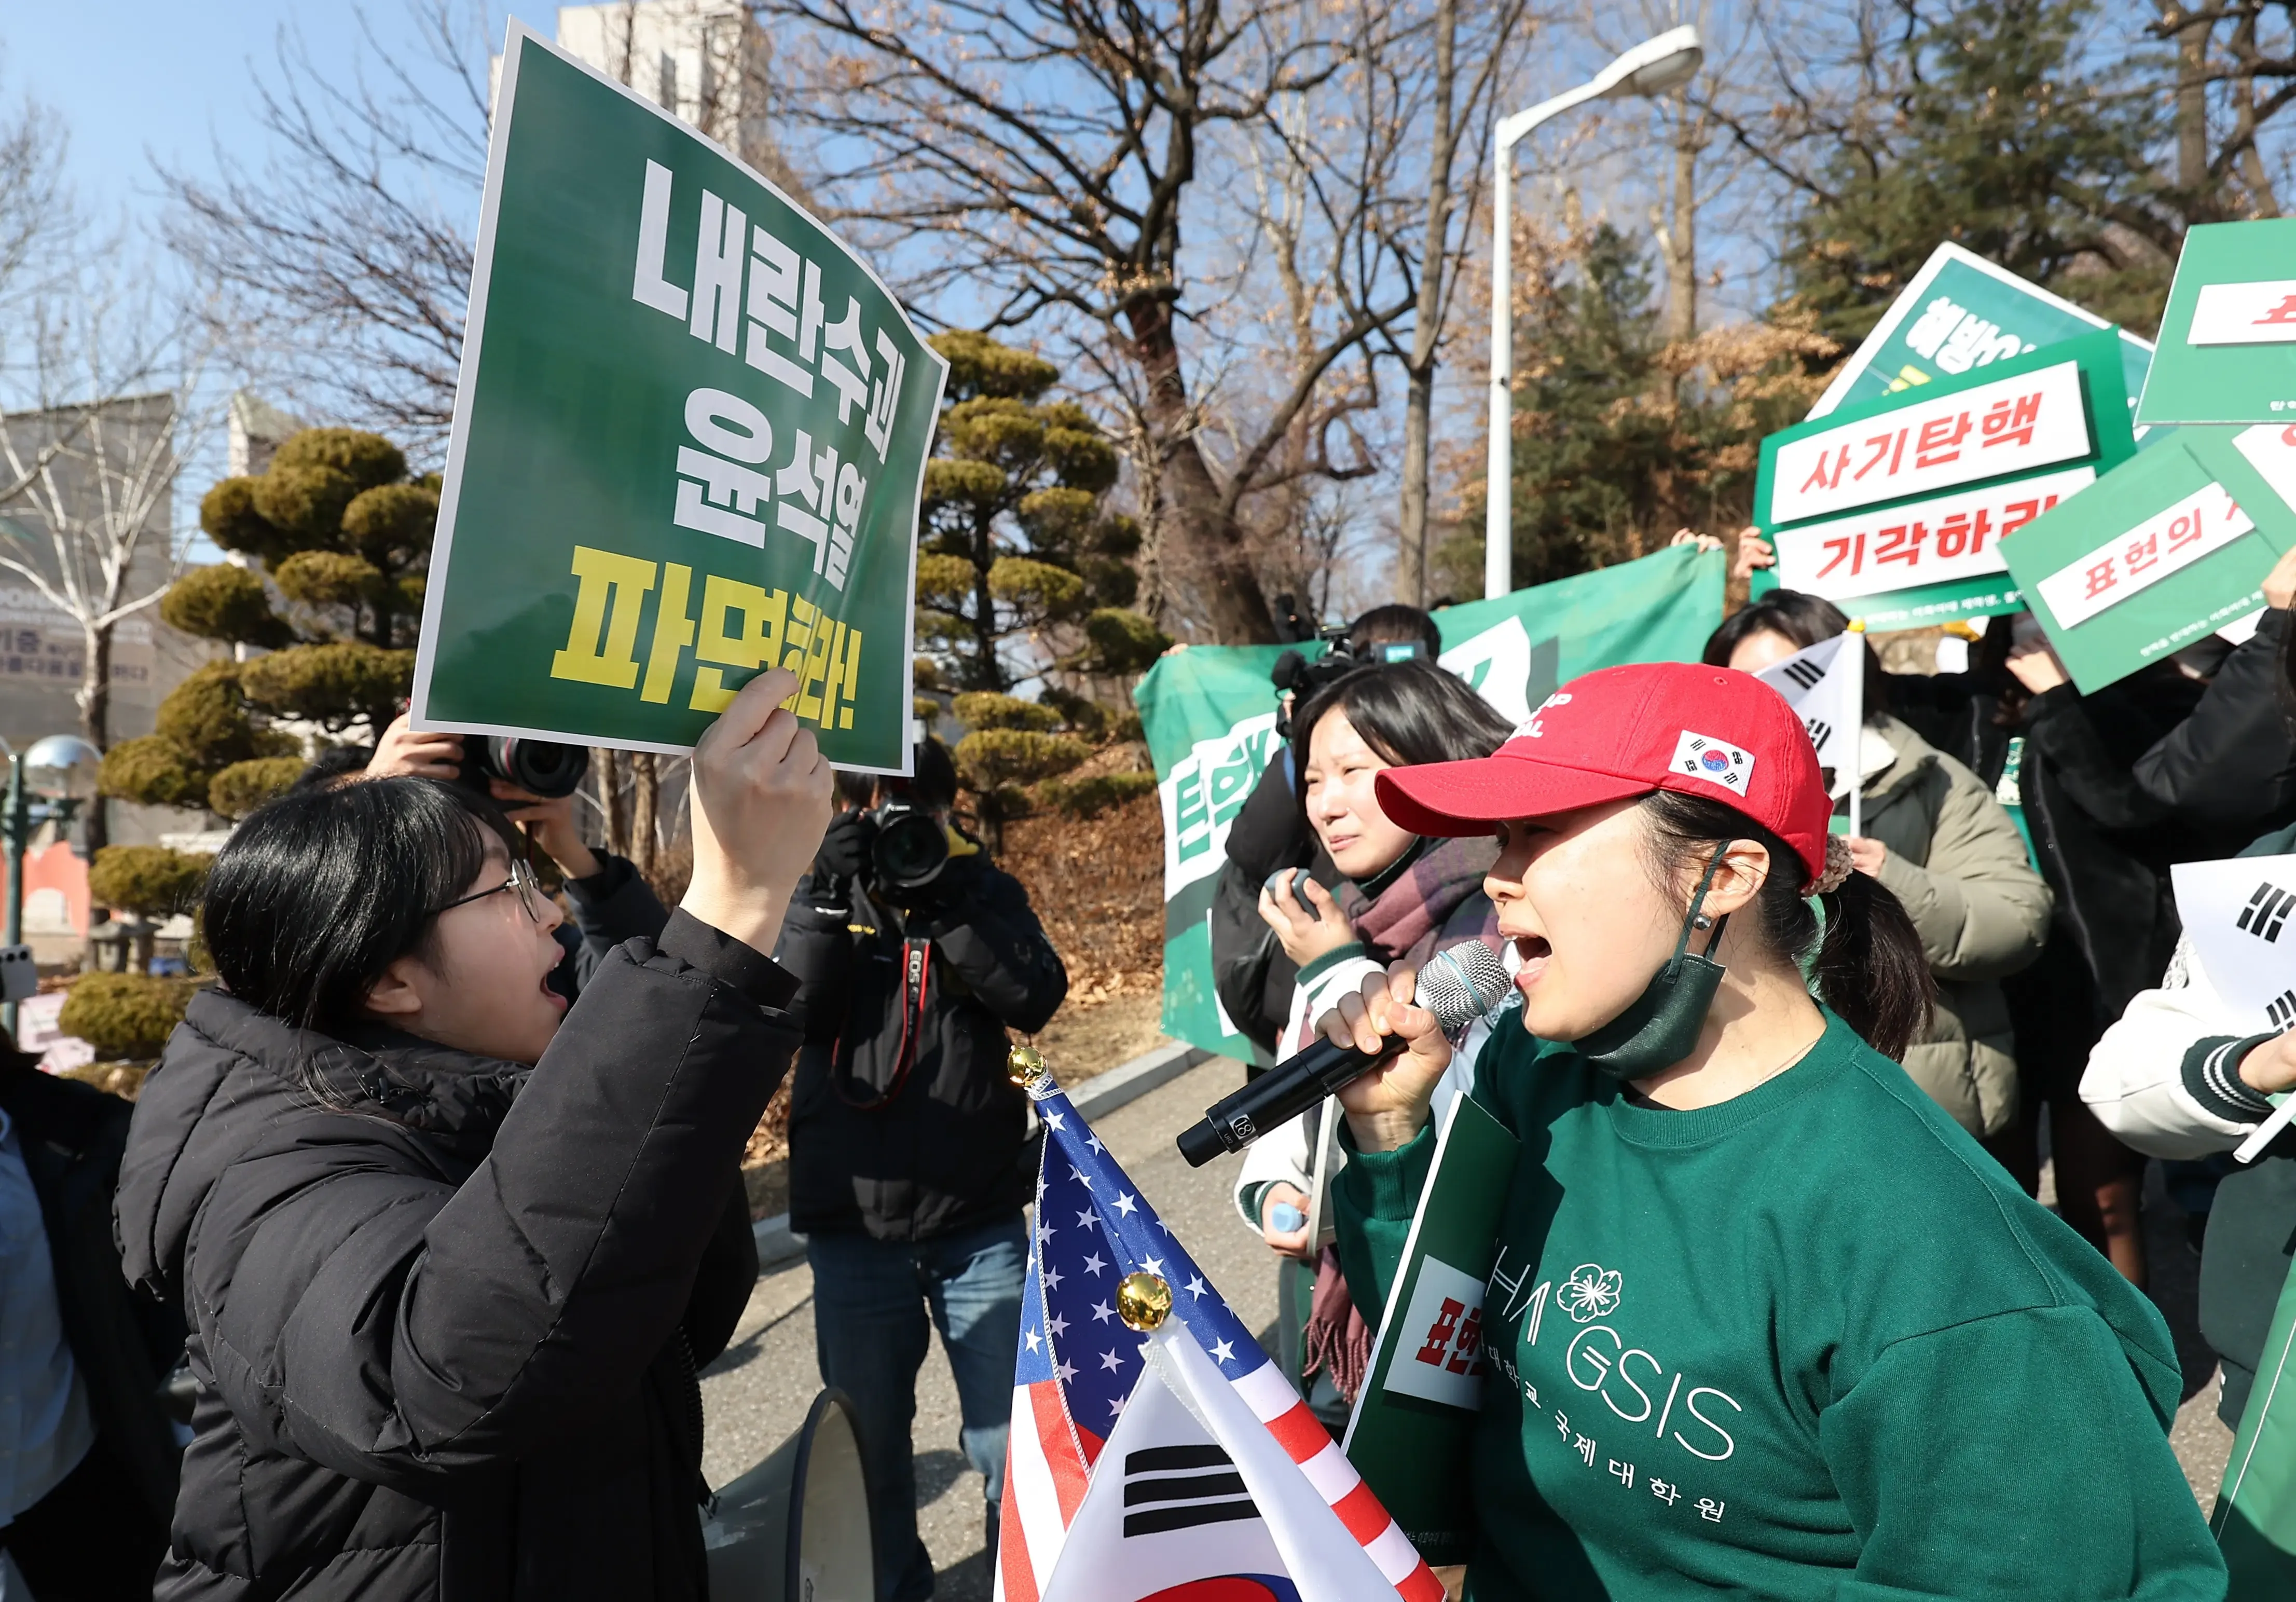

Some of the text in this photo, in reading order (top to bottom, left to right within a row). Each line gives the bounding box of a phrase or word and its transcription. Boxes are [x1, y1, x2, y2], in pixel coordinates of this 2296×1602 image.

[633, 158, 905, 464] 내란수괴
[673, 387, 868, 592] 윤석열
[1799, 392, 2043, 494] 사기탄핵
[909, 950, 922, 983] EOS
[1224, 1133, 1233, 1144] UR2
[1234, 1118, 1252, 1135] 18
[1566, 1325, 1742, 1461] GSIS
[1555, 1409, 1725, 1523] 국제대학원
